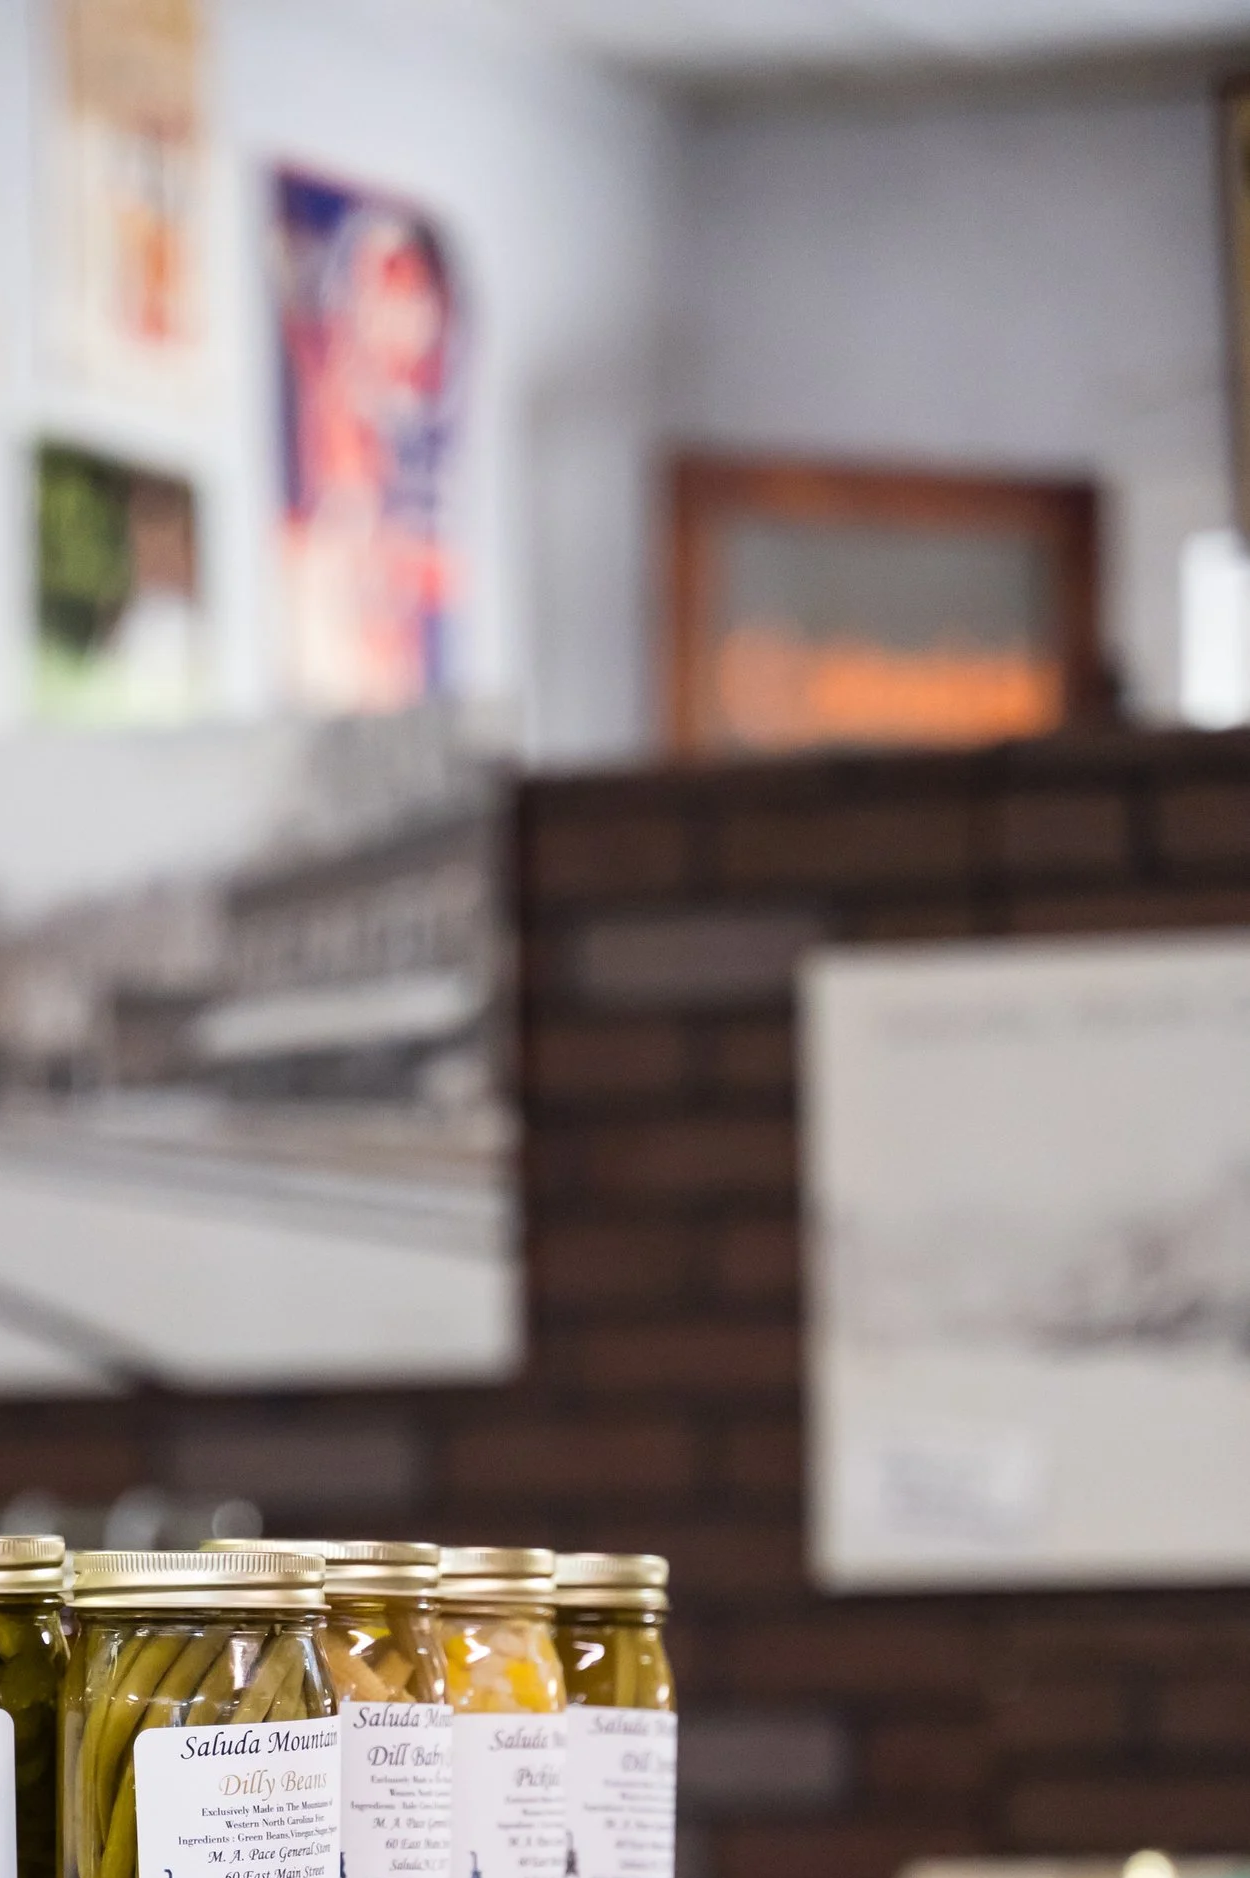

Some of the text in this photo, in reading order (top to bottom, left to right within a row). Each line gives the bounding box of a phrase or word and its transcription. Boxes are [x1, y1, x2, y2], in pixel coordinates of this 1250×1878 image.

[353, 1704, 420, 1729] Saluda
[180, 1725, 337, 1760] Saluda Mountain
[368, 1743, 410, 1767] Dill
[219, 1770, 275, 1801] Dilly
[281, 1771, 327, 1793] Beans
[202, 1804, 250, 1817] Exclusively
[253, 1805, 273, 1814] Made
[286, 1802, 299, 1811] The
[225, 1818, 285, 1830] Western North
[178, 1833, 263, 1846] Ingredients Green
[250, 1842, 314, 1862] Pace General
